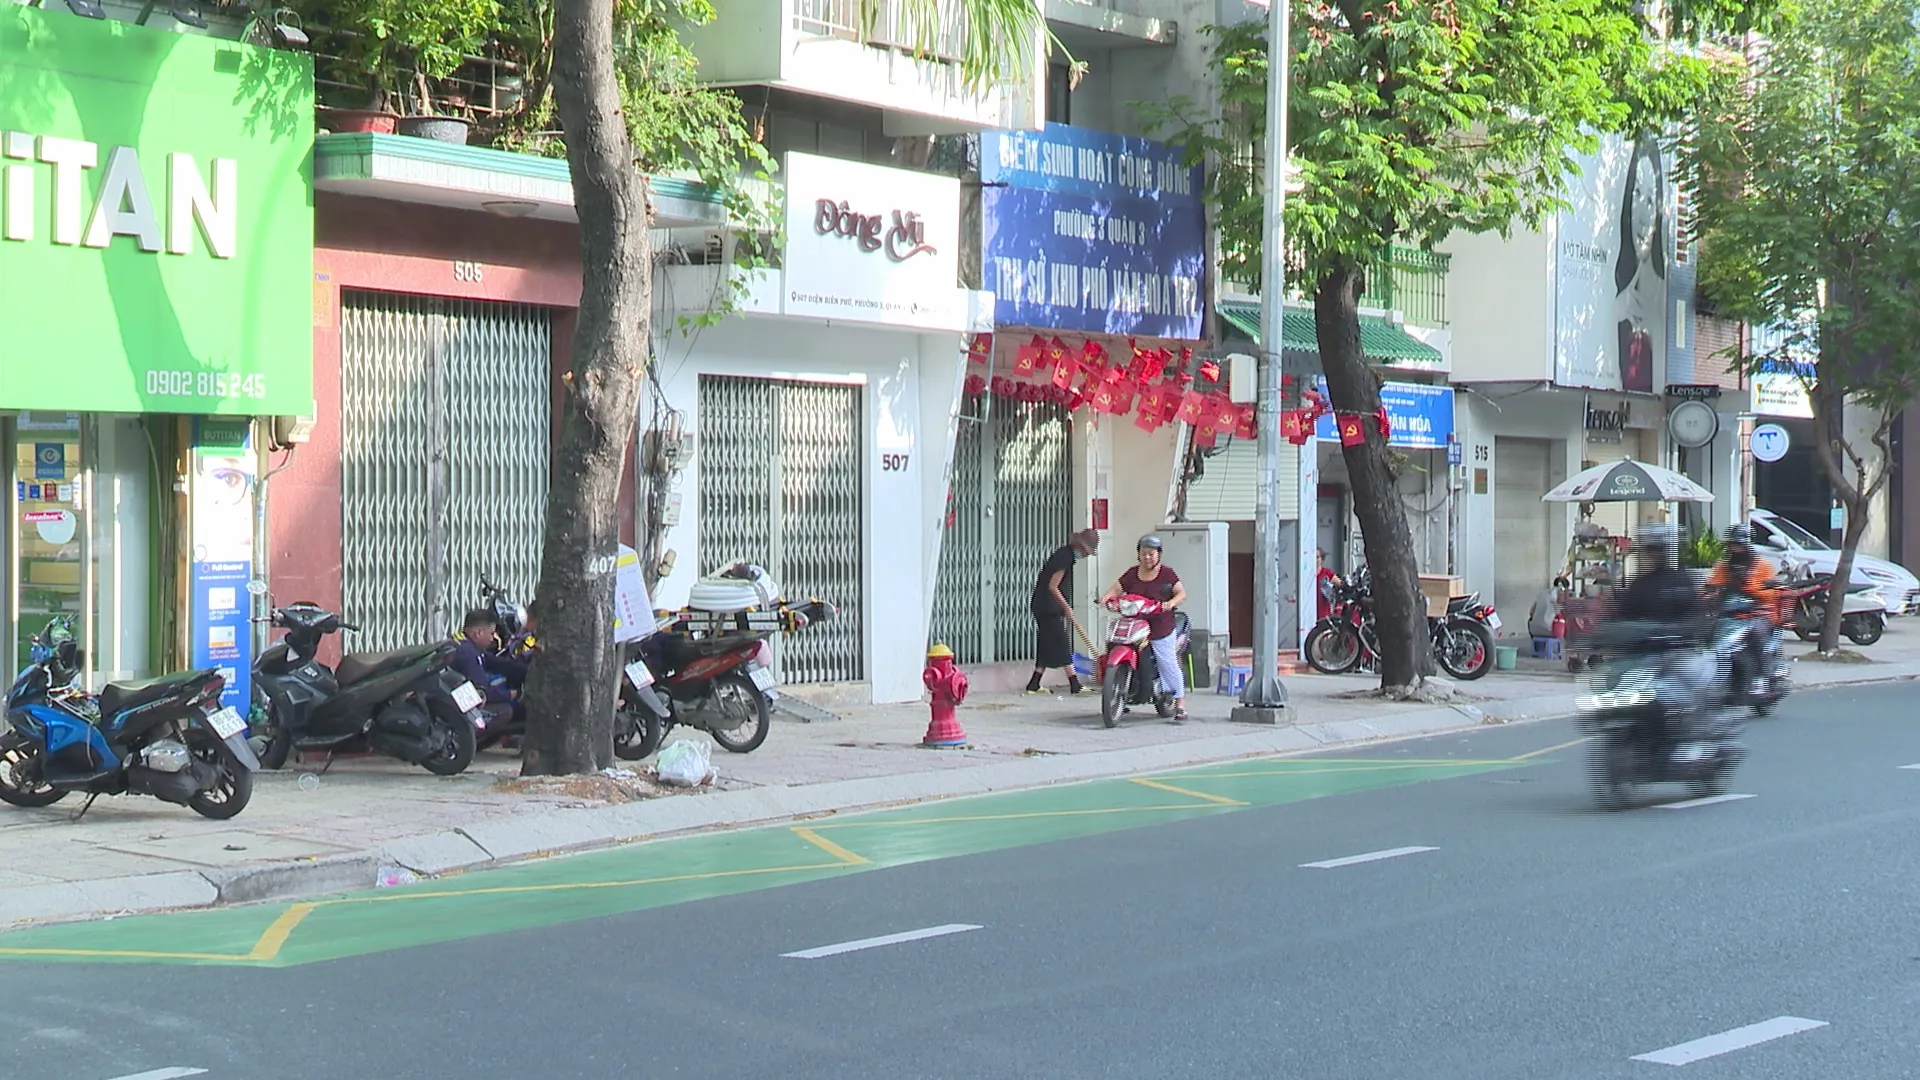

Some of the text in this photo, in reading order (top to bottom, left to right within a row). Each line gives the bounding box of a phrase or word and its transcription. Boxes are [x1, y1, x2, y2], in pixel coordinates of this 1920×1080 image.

[1042, 141, 1074, 178] SINH
[1078, 147, 1113, 188] HOẠT
[1118, 150, 1152, 194] CỘNG
[1157, 153, 1191, 196] ĐỒNG
[814, 198, 882, 253] Đông
[1053, 208, 1146, 249] PHƯỜNG 3 QUẬN 3
[453, 260, 483, 283] 505
[994, 256, 1022, 309] TRỤ
[1028, 249, 1047, 306] SỞ
[1051, 262, 1078, 308] KHU
[1082, 256, 1108, 312] PHỐ
[1112, 263, 1142, 313] VĂN
[1144, 266, 1171, 316] HÓA
[146, 369, 265, 398] 0902 815 245
[1409, 413, 1432, 433] HÓA
[204, 430, 241, 440] BUTITAN
[1759, 431, 1778, 450] T
[882, 453, 909, 472] 507
[1475, 444, 1489, 462] 515
[589, 555, 616, 574] 407
